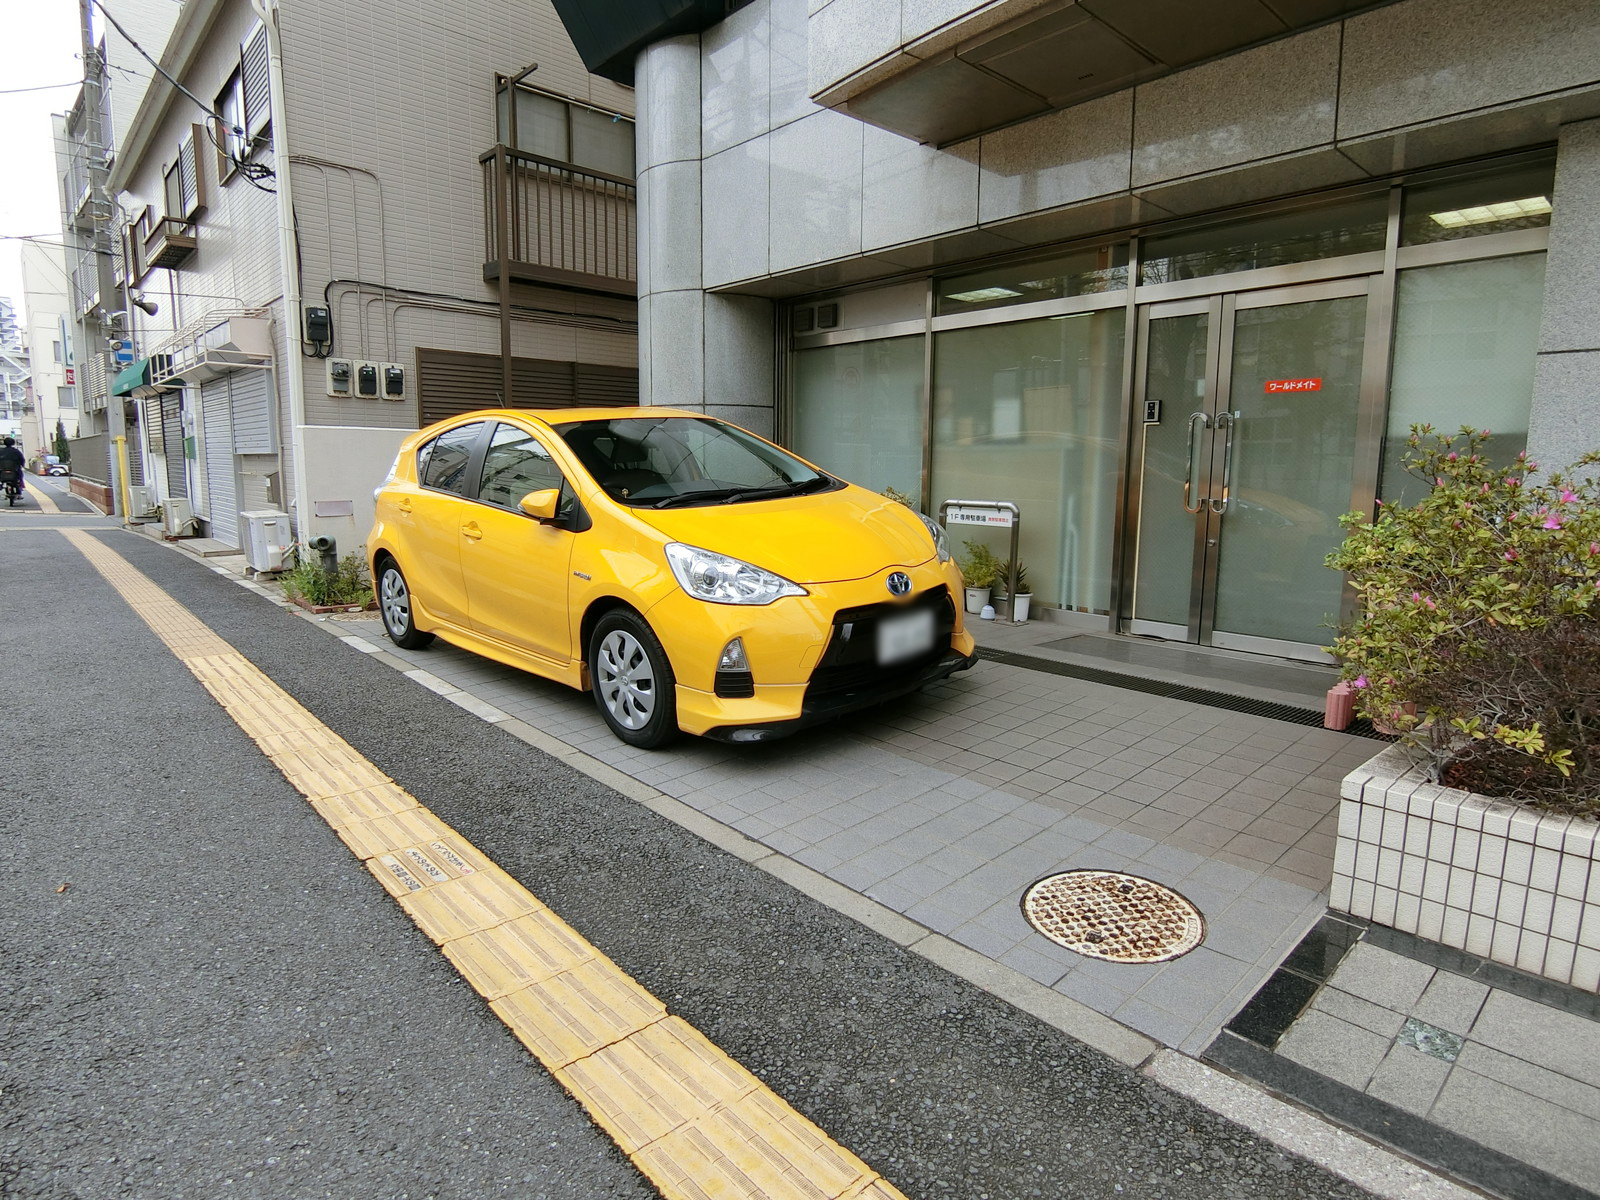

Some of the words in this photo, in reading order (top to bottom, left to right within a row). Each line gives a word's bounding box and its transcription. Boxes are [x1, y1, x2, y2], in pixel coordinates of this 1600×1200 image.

[1269, 381, 1316, 391] ワールドメイト
